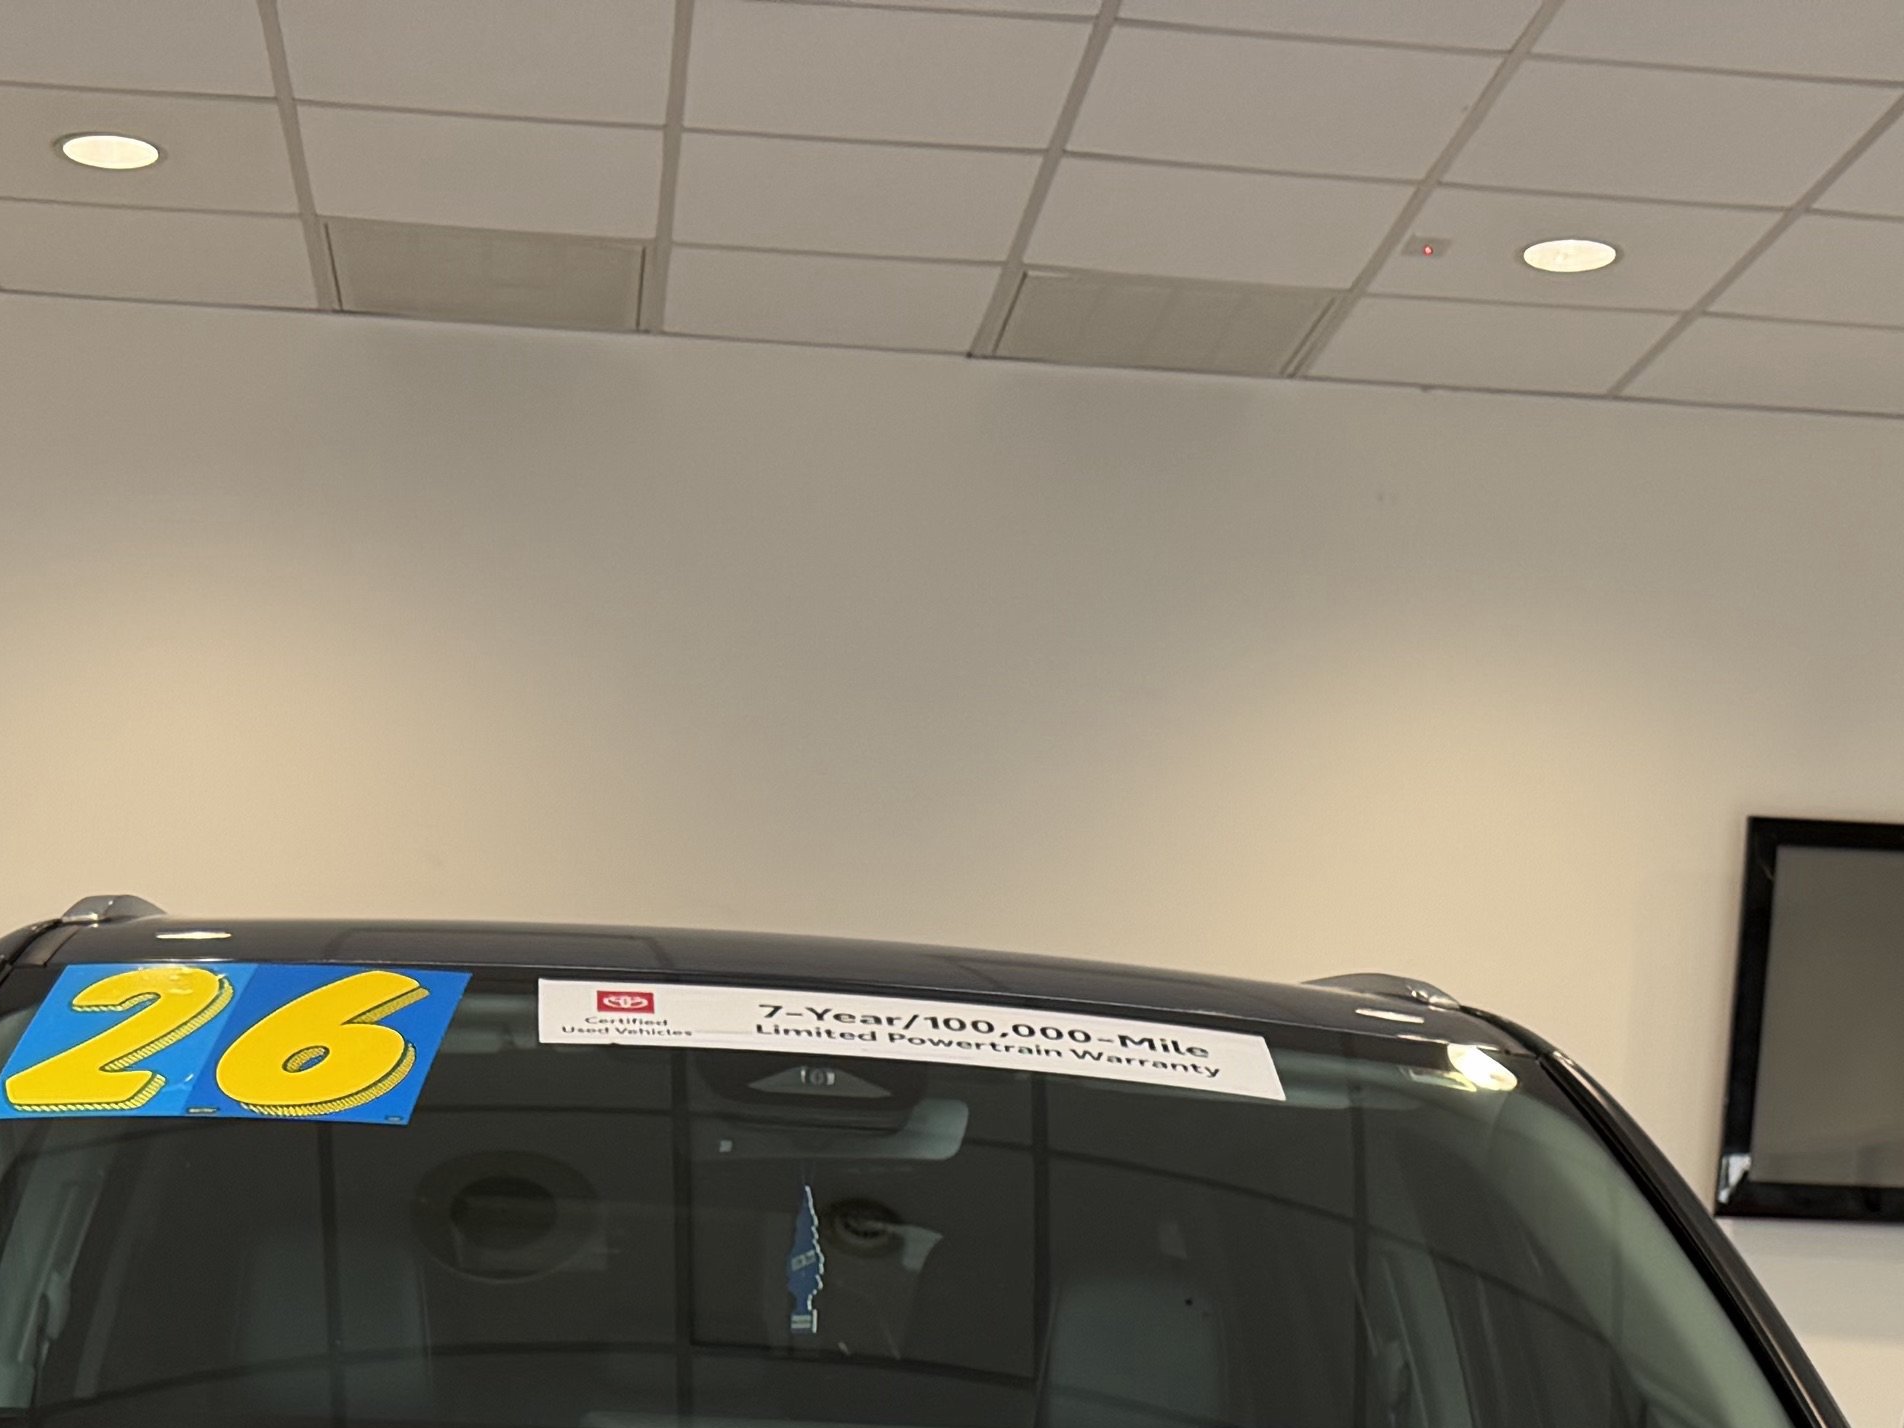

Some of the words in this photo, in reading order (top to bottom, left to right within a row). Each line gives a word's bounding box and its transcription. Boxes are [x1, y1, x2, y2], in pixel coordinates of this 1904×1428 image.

[4, 966, 430, 1117] 26
[562, 1026, 609, 1035] Used
[615, 1027, 692, 1036] Vehicles
[585, 1016, 668, 1027] Certified
[758, 1004, 1209, 1058] 7-Year/100,000-Mile
[756, 1024, 877, 1042] Limited
[888, 1032, 1062, 1057] Powertrain
[1070, 1050, 1220, 1078] Warranty
